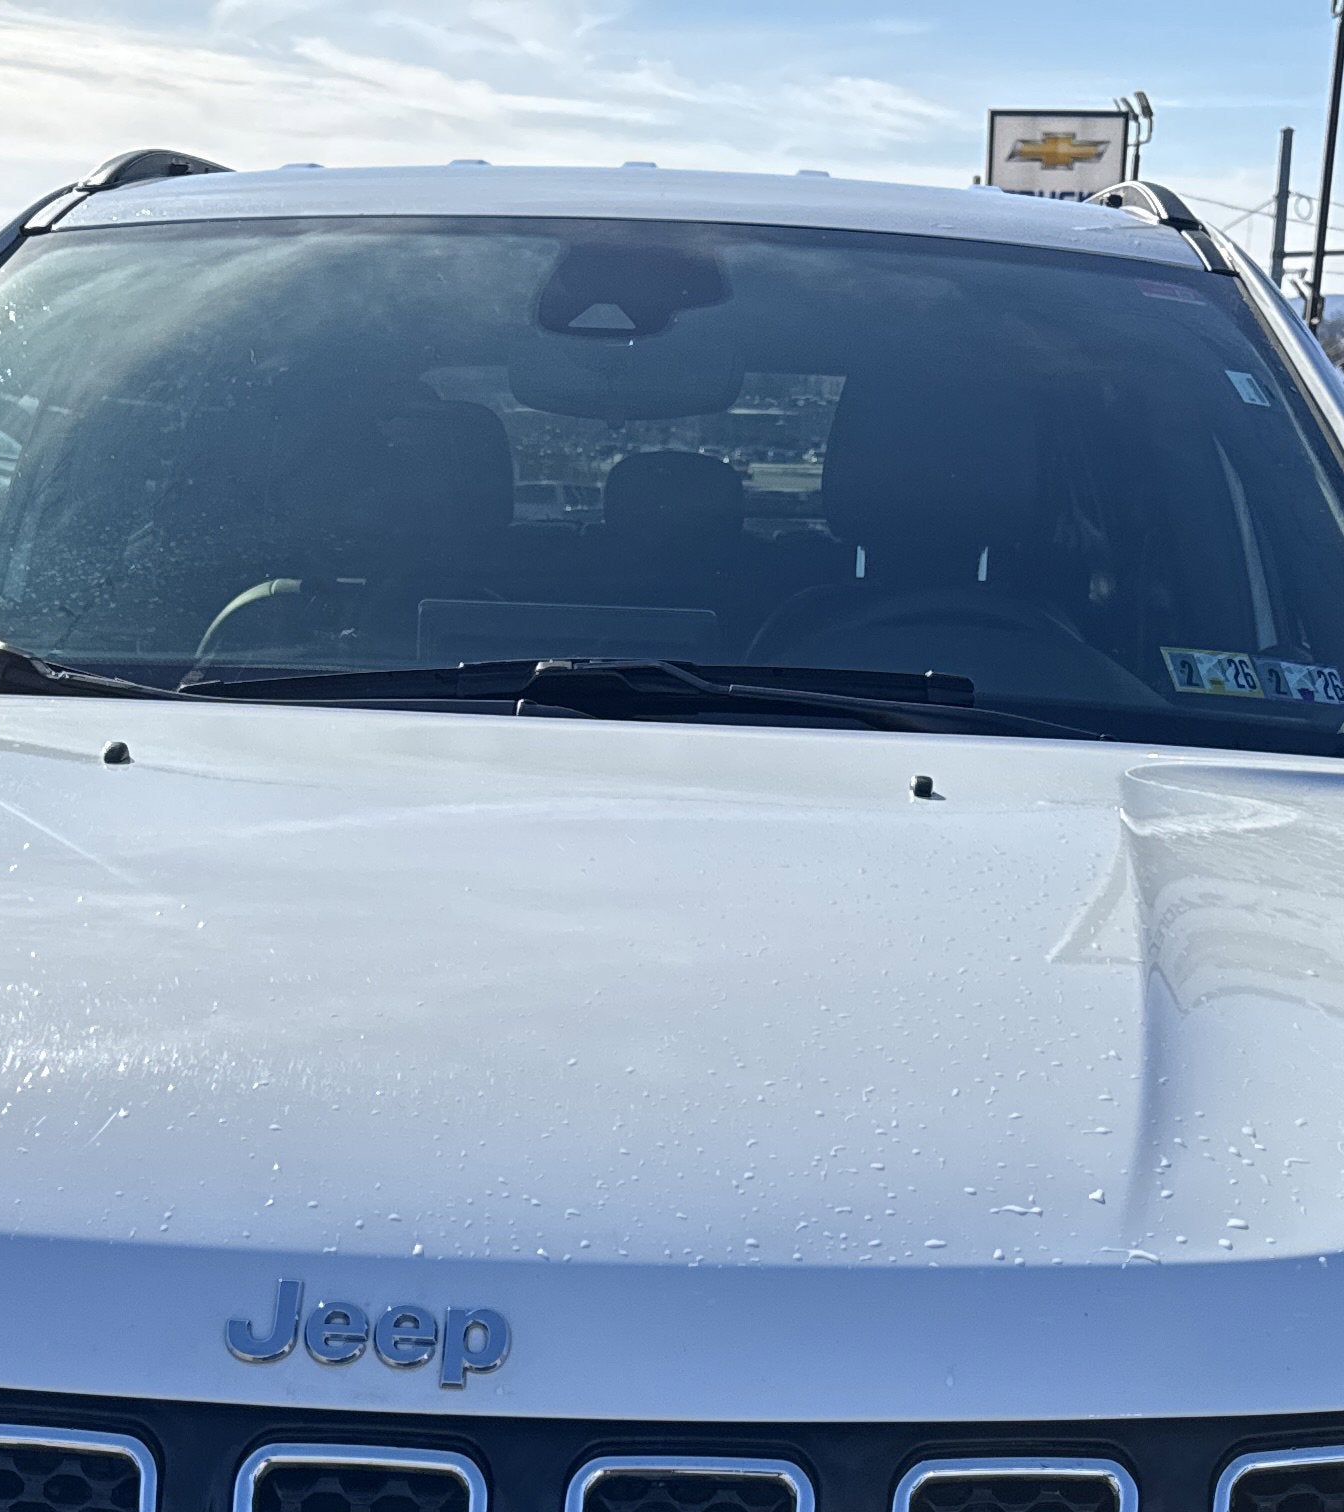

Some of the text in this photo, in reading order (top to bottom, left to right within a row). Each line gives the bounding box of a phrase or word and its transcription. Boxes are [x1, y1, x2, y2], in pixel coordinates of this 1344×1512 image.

[1179, 658, 1257, 690] 2 26
[1267, 668, 1288, 696] 2
[226, 1278, 512, 1390] Jeep
